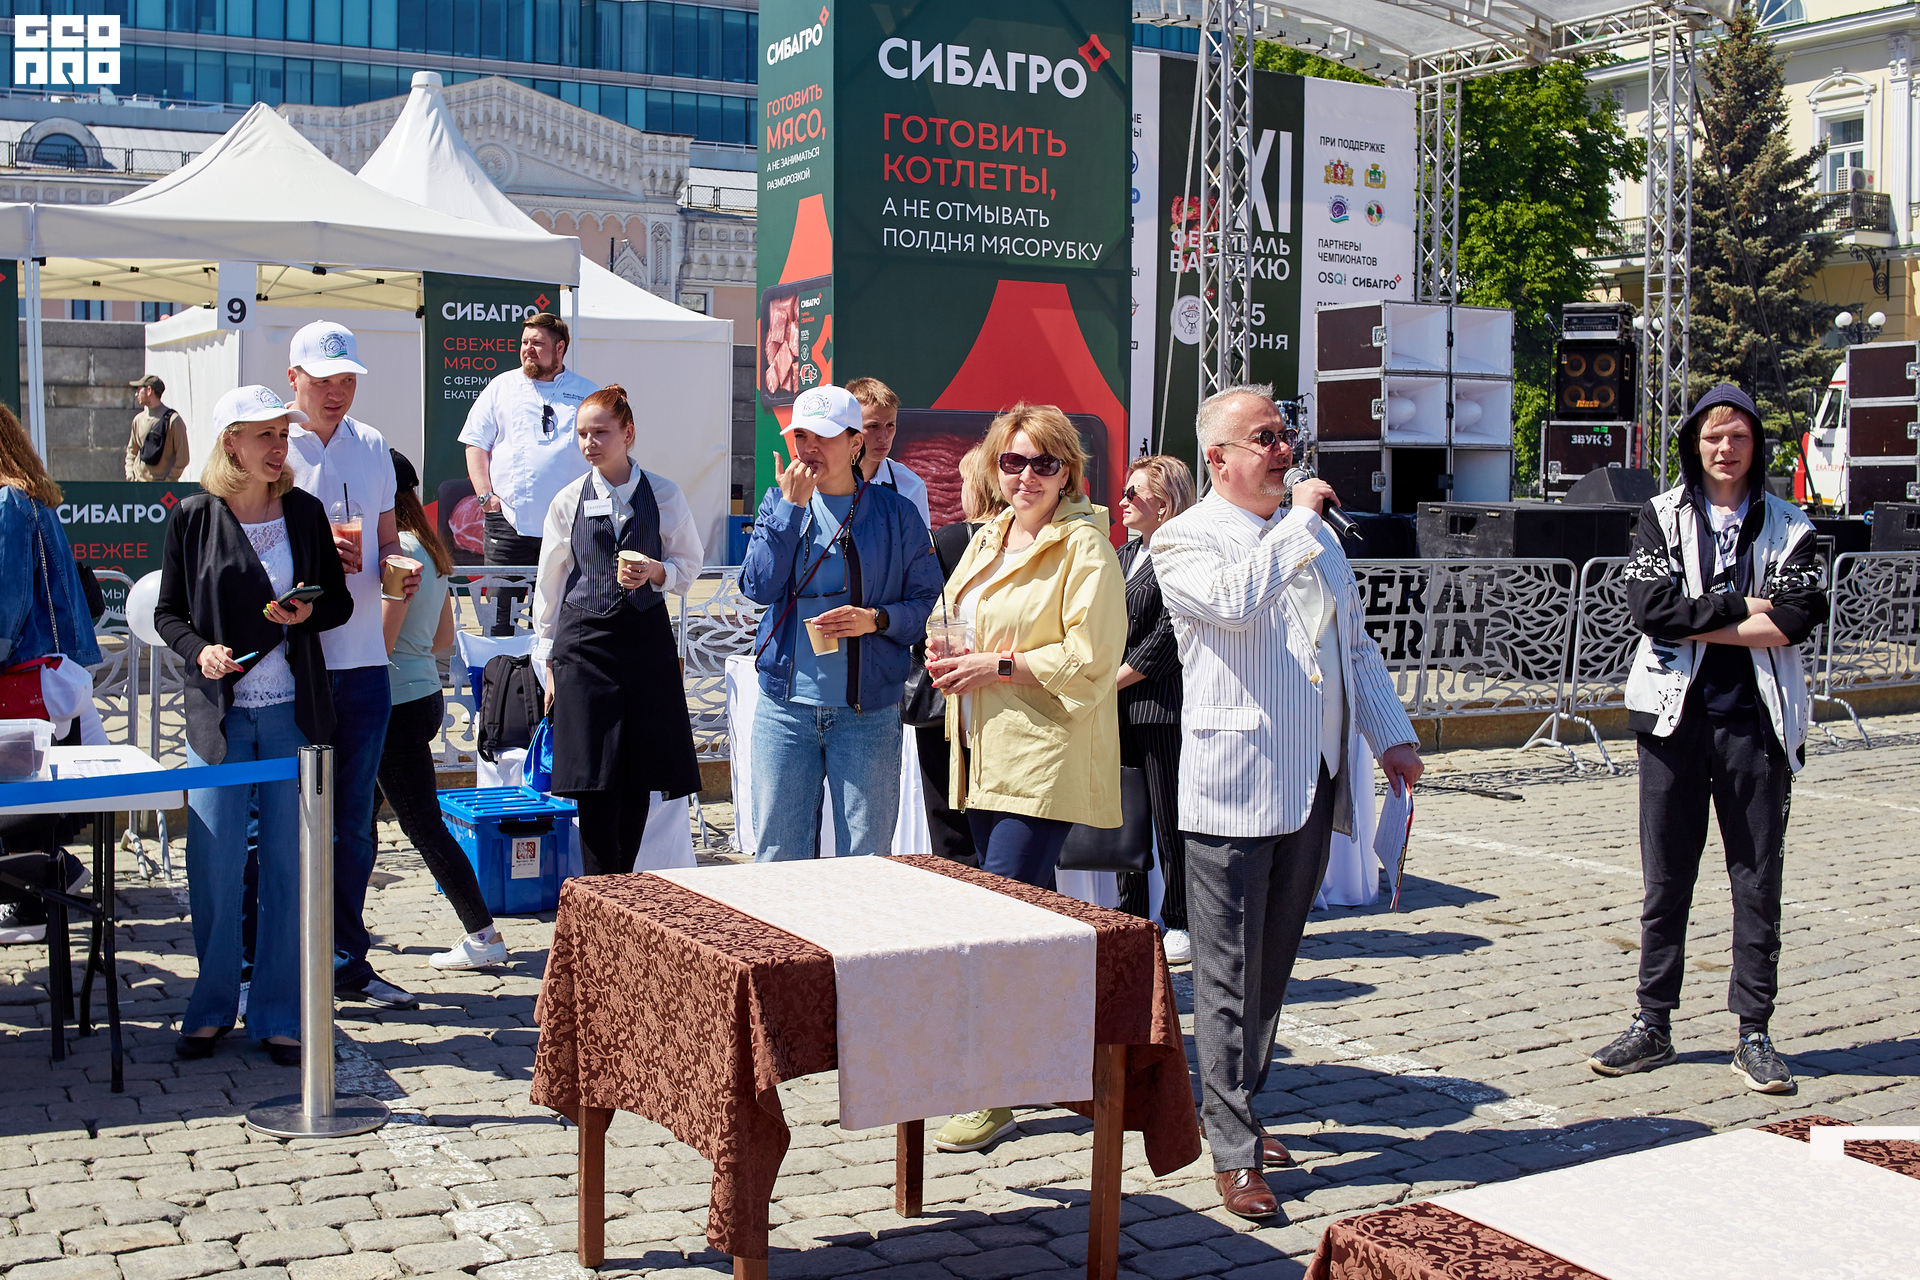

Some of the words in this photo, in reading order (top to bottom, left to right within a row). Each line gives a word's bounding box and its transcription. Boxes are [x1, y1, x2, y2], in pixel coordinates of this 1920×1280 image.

[766, 22, 823, 66] СИБАГРО
[878, 37, 1088, 99] СИБАГРО
[766, 83, 823, 119] ГОТОВИТЬ
[766, 108, 826, 153] МЯСО,
[883, 113, 1067, 157] ГОТОВИТЬ
[1320, 136, 1336, 147] ПРИ
[1338, 138, 1386, 154] ПОДДЕРЖКЕ
[766, 163, 772, 172] А
[772, 160, 780, 170] НЕ
[780, 146, 820, 168] ЗАНИМАТЬСЯ
[766, 168, 811, 191] РАЗМОРОЗКОЙ
[883, 153, 1057, 200] КОТЛЕТЫ,
[882, 197, 898, 216] А
[904, 199, 930, 219] НЕ
[936, 201, 1050, 228] ОТМЫВАТЬ
[883, 228, 975, 253] ПОЛДНЯ
[982, 235, 1103, 261] МЯСОРУБКУ
[1318, 238, 1362, 252] ПАРТНЕРЫ
[1318, 252, 1378, 266] ЧЕМПИОНАТОВ
[1318, 272, 1343, 285] OSQ
[1352, 276, 1397, 290] СИБАГРО
[226, 297, 247, 324] 9
[443, 337, 517, 352] СВЕЖЕЕ
[444, 356, 498, 370] МЯСО
[444, 376, 452, 386] С
[444, 390, 482, 400] ЕКАТЕ
[1571, 434, 1602, 444] ЗВУК
[1604, 434, 1612, 446] 3
[58, 503, 167, 524] СИБАГРО
[69, 542, 148, 560] ВЕЖЕЕ
